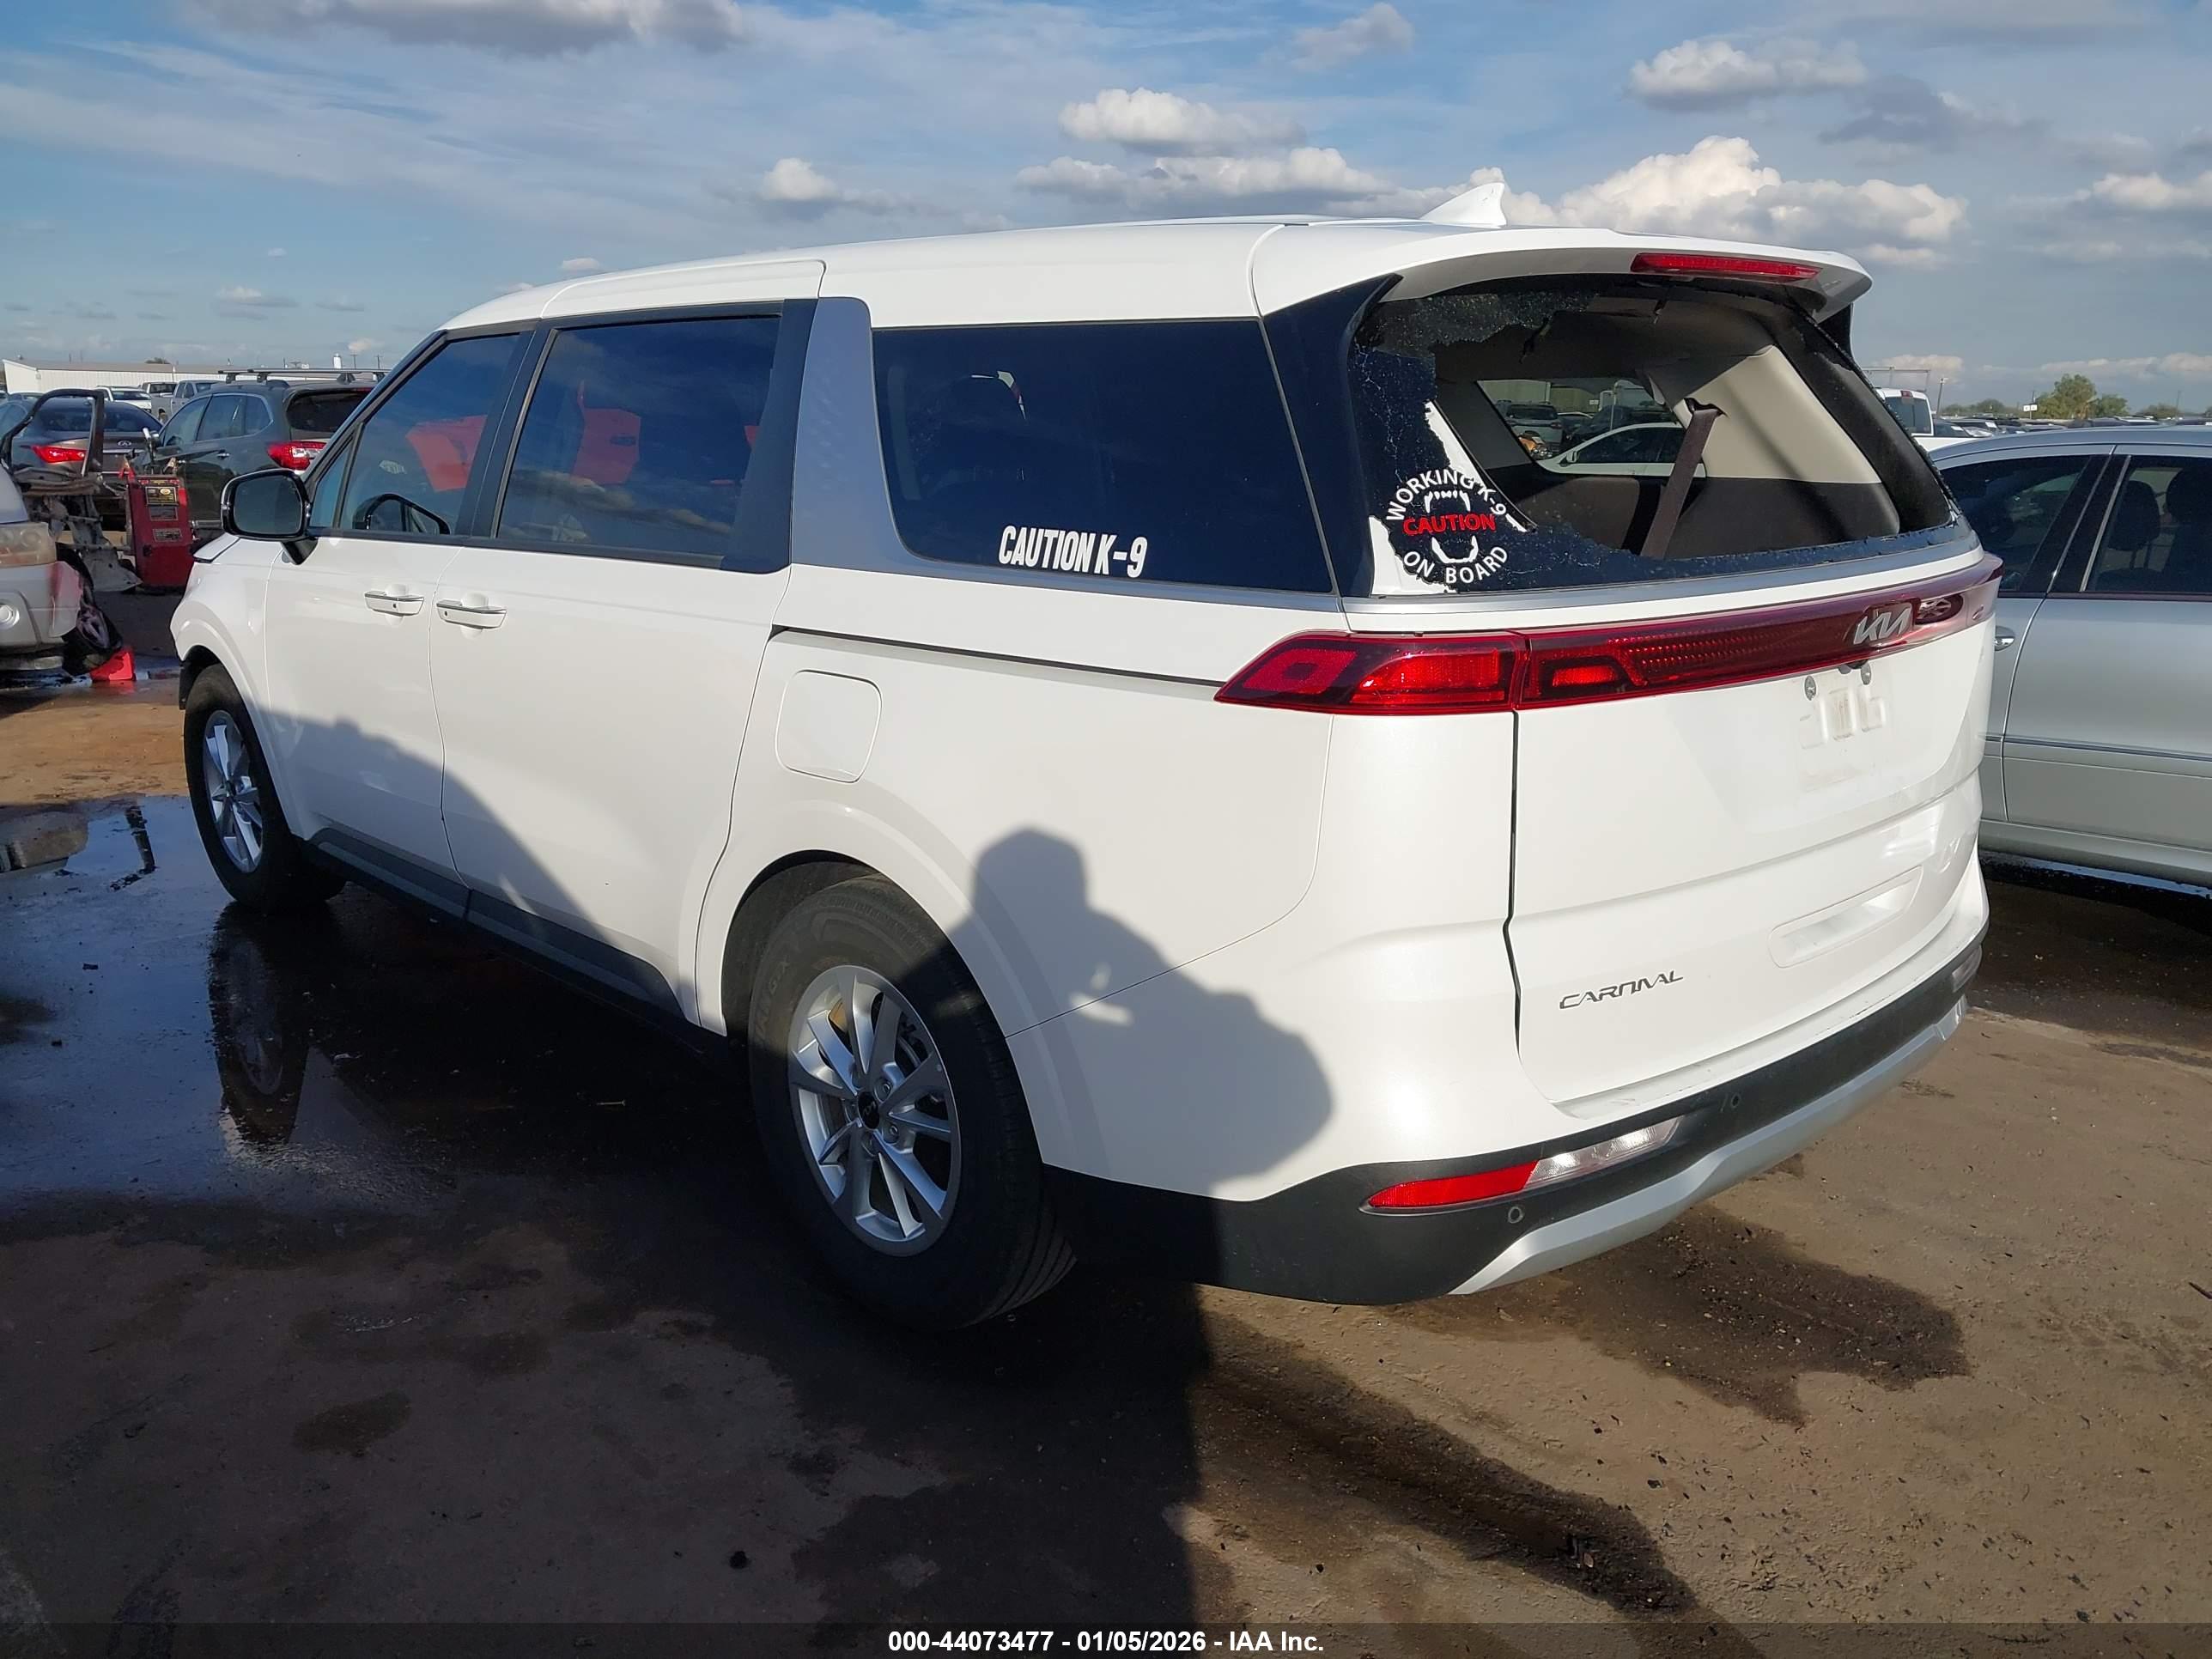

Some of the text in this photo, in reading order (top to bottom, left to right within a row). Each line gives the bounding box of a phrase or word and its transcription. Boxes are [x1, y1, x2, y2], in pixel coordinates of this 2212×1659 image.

[1386, 469, 1507, 520] WORKING K-9
[1403, 514, 1496, 536] CAUTION
[999, 526, 1148, 578] CAUTION K-9
[1403, 546, 1508, 584] ON BOARD
[1559, 970, 1683, 1010] CARNIVAL
